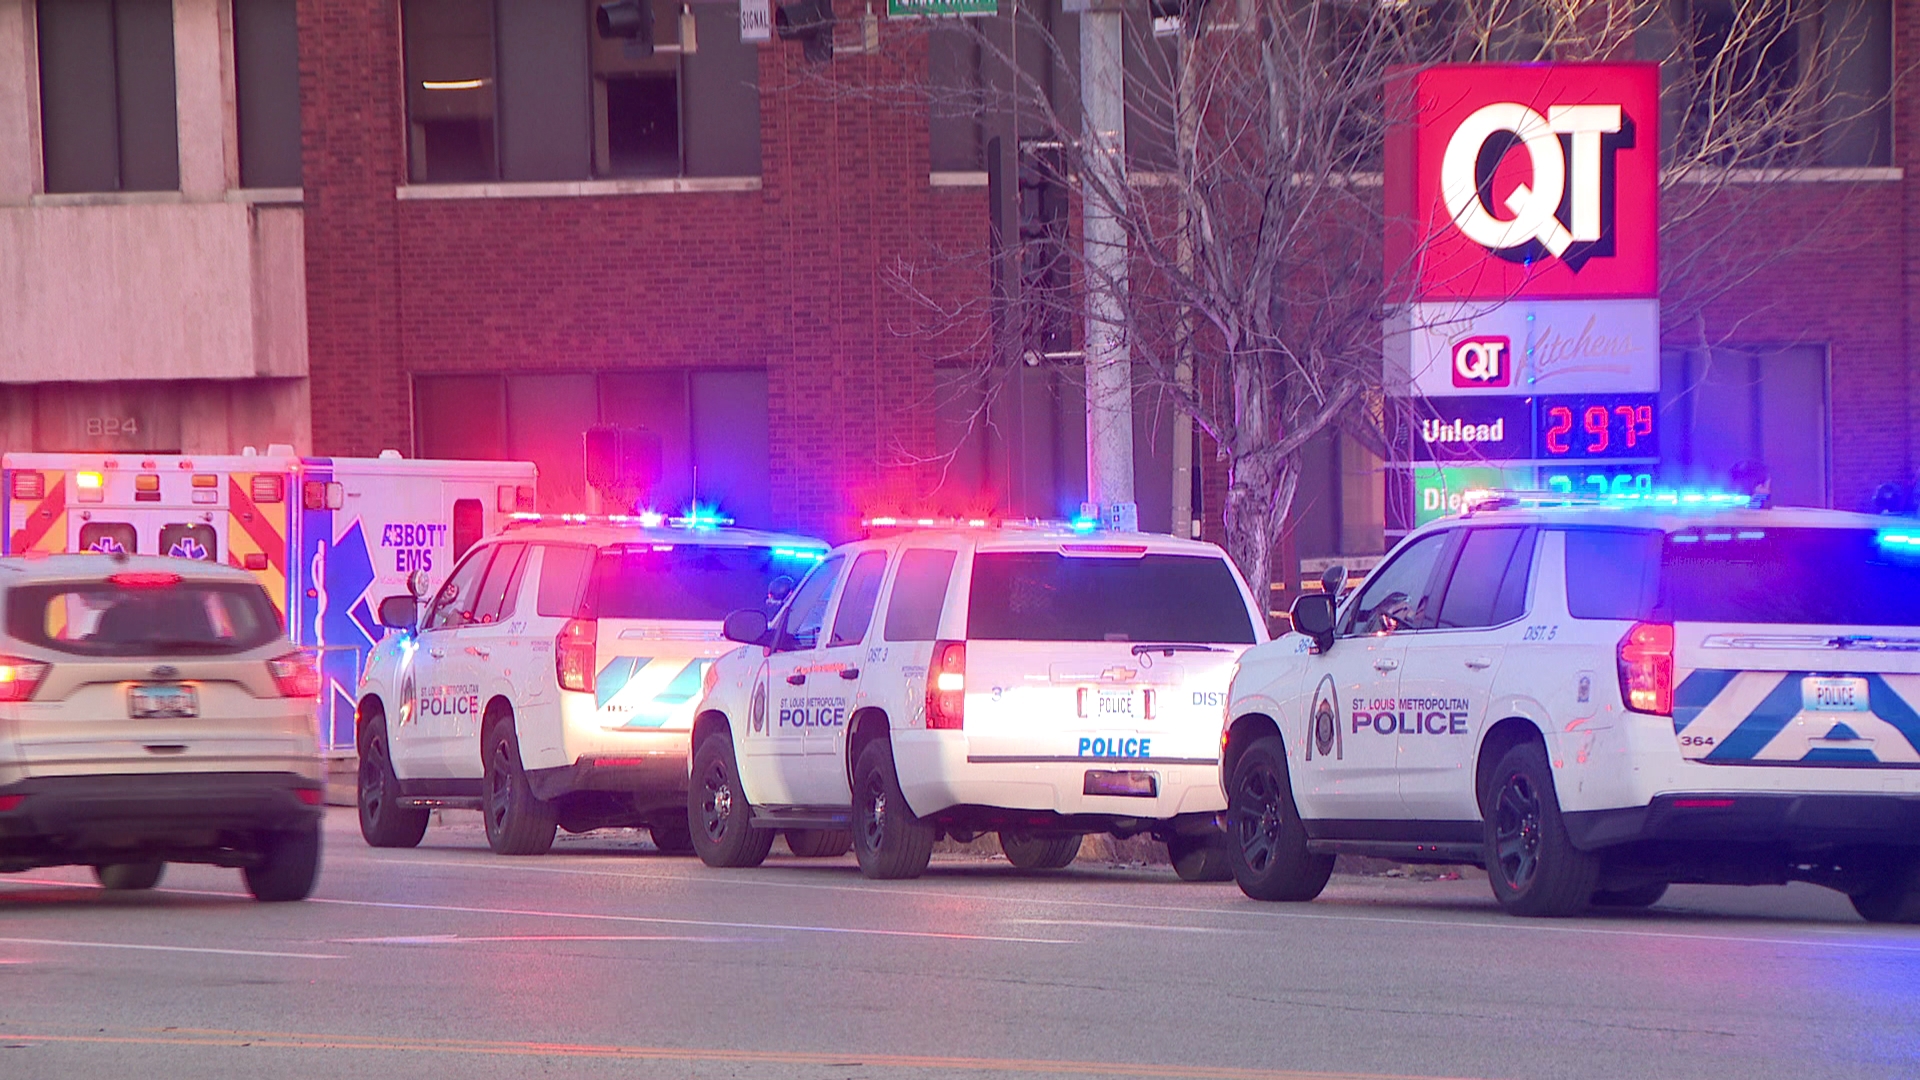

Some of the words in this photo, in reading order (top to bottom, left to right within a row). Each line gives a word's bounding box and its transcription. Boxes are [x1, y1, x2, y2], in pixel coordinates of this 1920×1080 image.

[742, 10, 768, 30] SIGNAL
[1440, 101, 1622, 259] QT
[1455, 341, 1505, 381] QT
[1513, 314, 1645, 388] Kitchens
[86, 417, 138, 436] 824
[1422, 418, 1504, 443] Unlead
[1423, 487, 1463, 511] Die
[381, 523, 447, 547] ABBOTT
[396, 548, 432, 572] EMS
[1523, 625, 1547, 641] DIST.
[1547, 625, 1559, 641] 5
[420, 696, 478, 716] POLICE
[789, 697, 805, 708] LOUIS
[1099, 697, 1132, 714] POLICE
[1352, 698, 1367, 710] ST.
[1369, 698, 1395, 710] LOUIS
[1398, 698, 1469, 710] METROPOLITAN
[1817, 687, 1855, 706] POLICE
[779, 708, 845, 727] POLICE
[1352, 711, 1468, 734] POLICE
[1078, 738, 1151, 757] POLICE
[1681, 735, 1715, 746] 364
